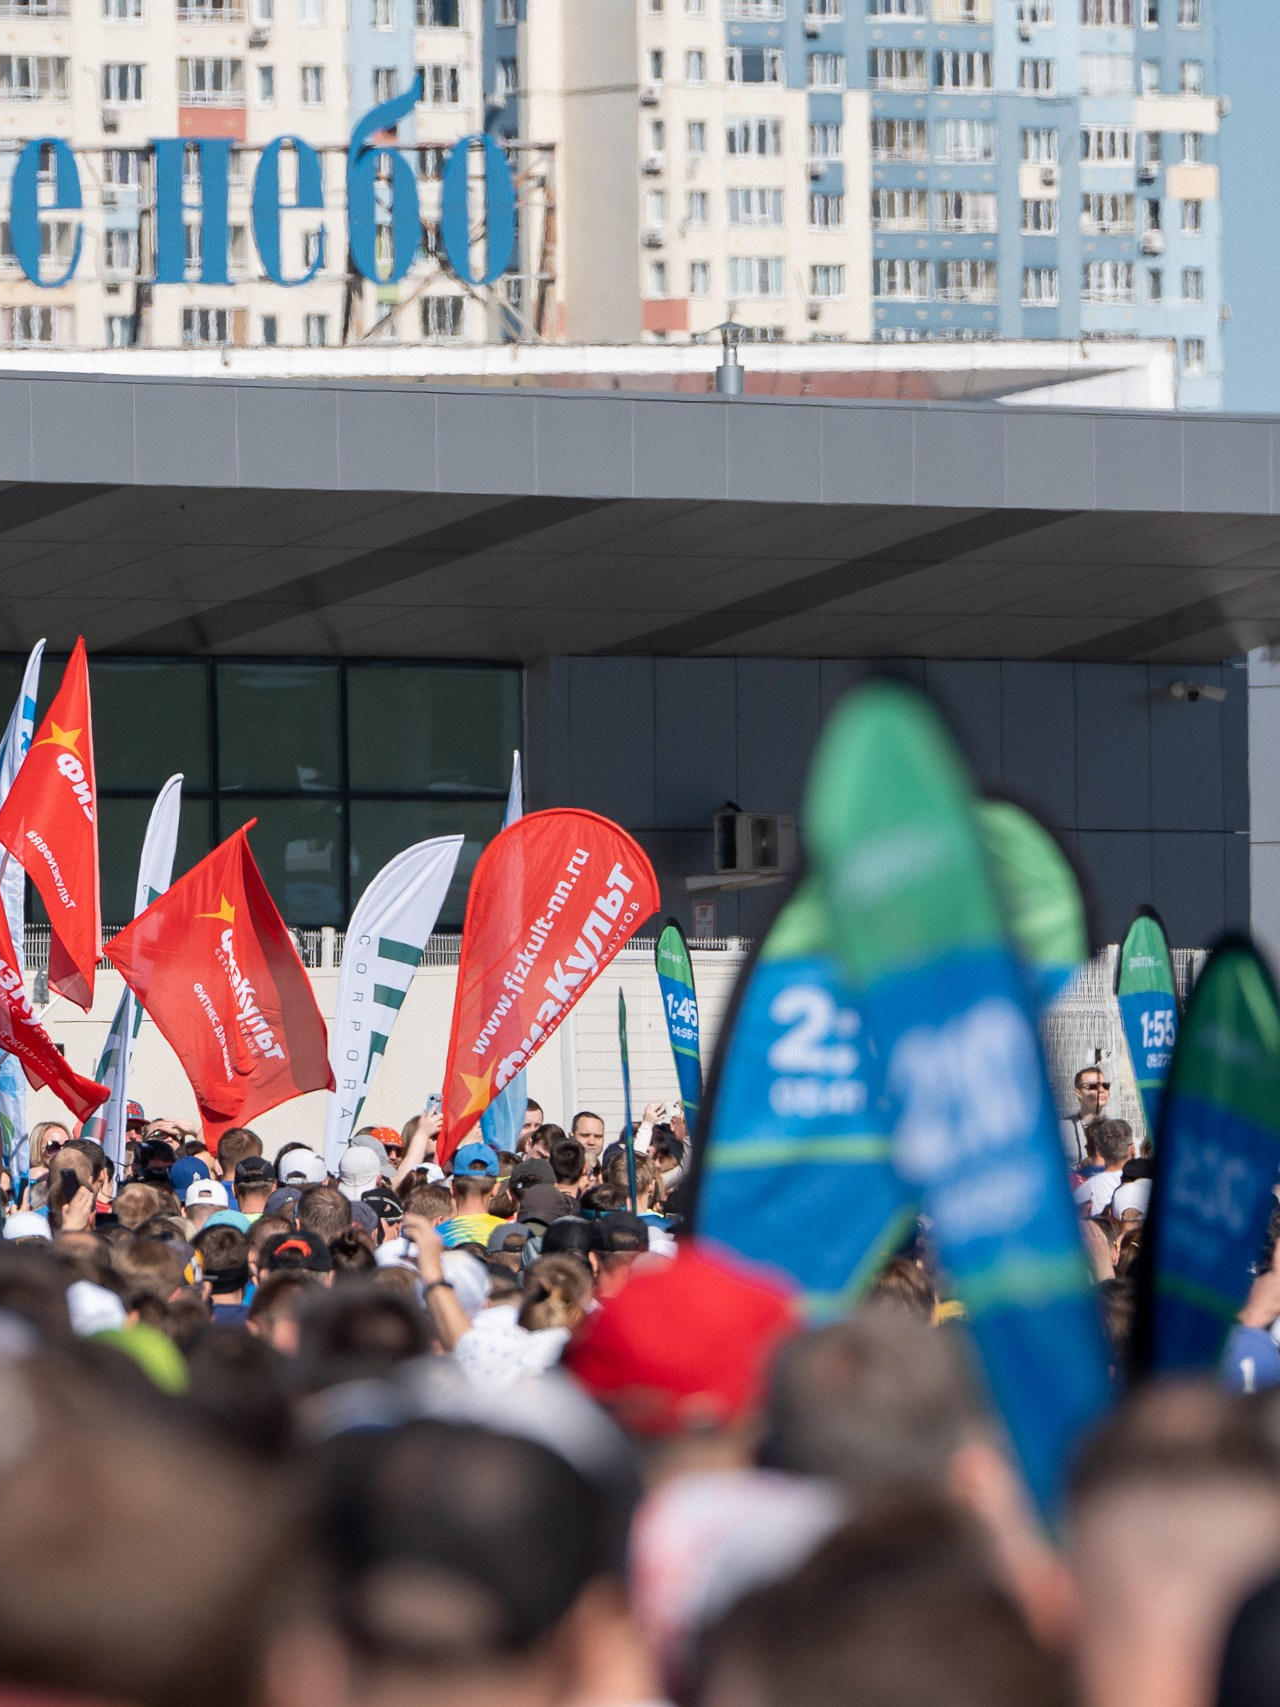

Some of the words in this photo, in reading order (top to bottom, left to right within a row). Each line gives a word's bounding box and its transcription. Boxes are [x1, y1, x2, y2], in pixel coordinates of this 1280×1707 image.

[151, 68, 515, 286] небо
[471, 847, 590, 1056] www.fizkult-nn.ru
[194, 982, 220, 1026] ФИТНЕС
[666, 992, 698, 1027] 1:45
[1140, 1009, 1176, 1049] 1:55
